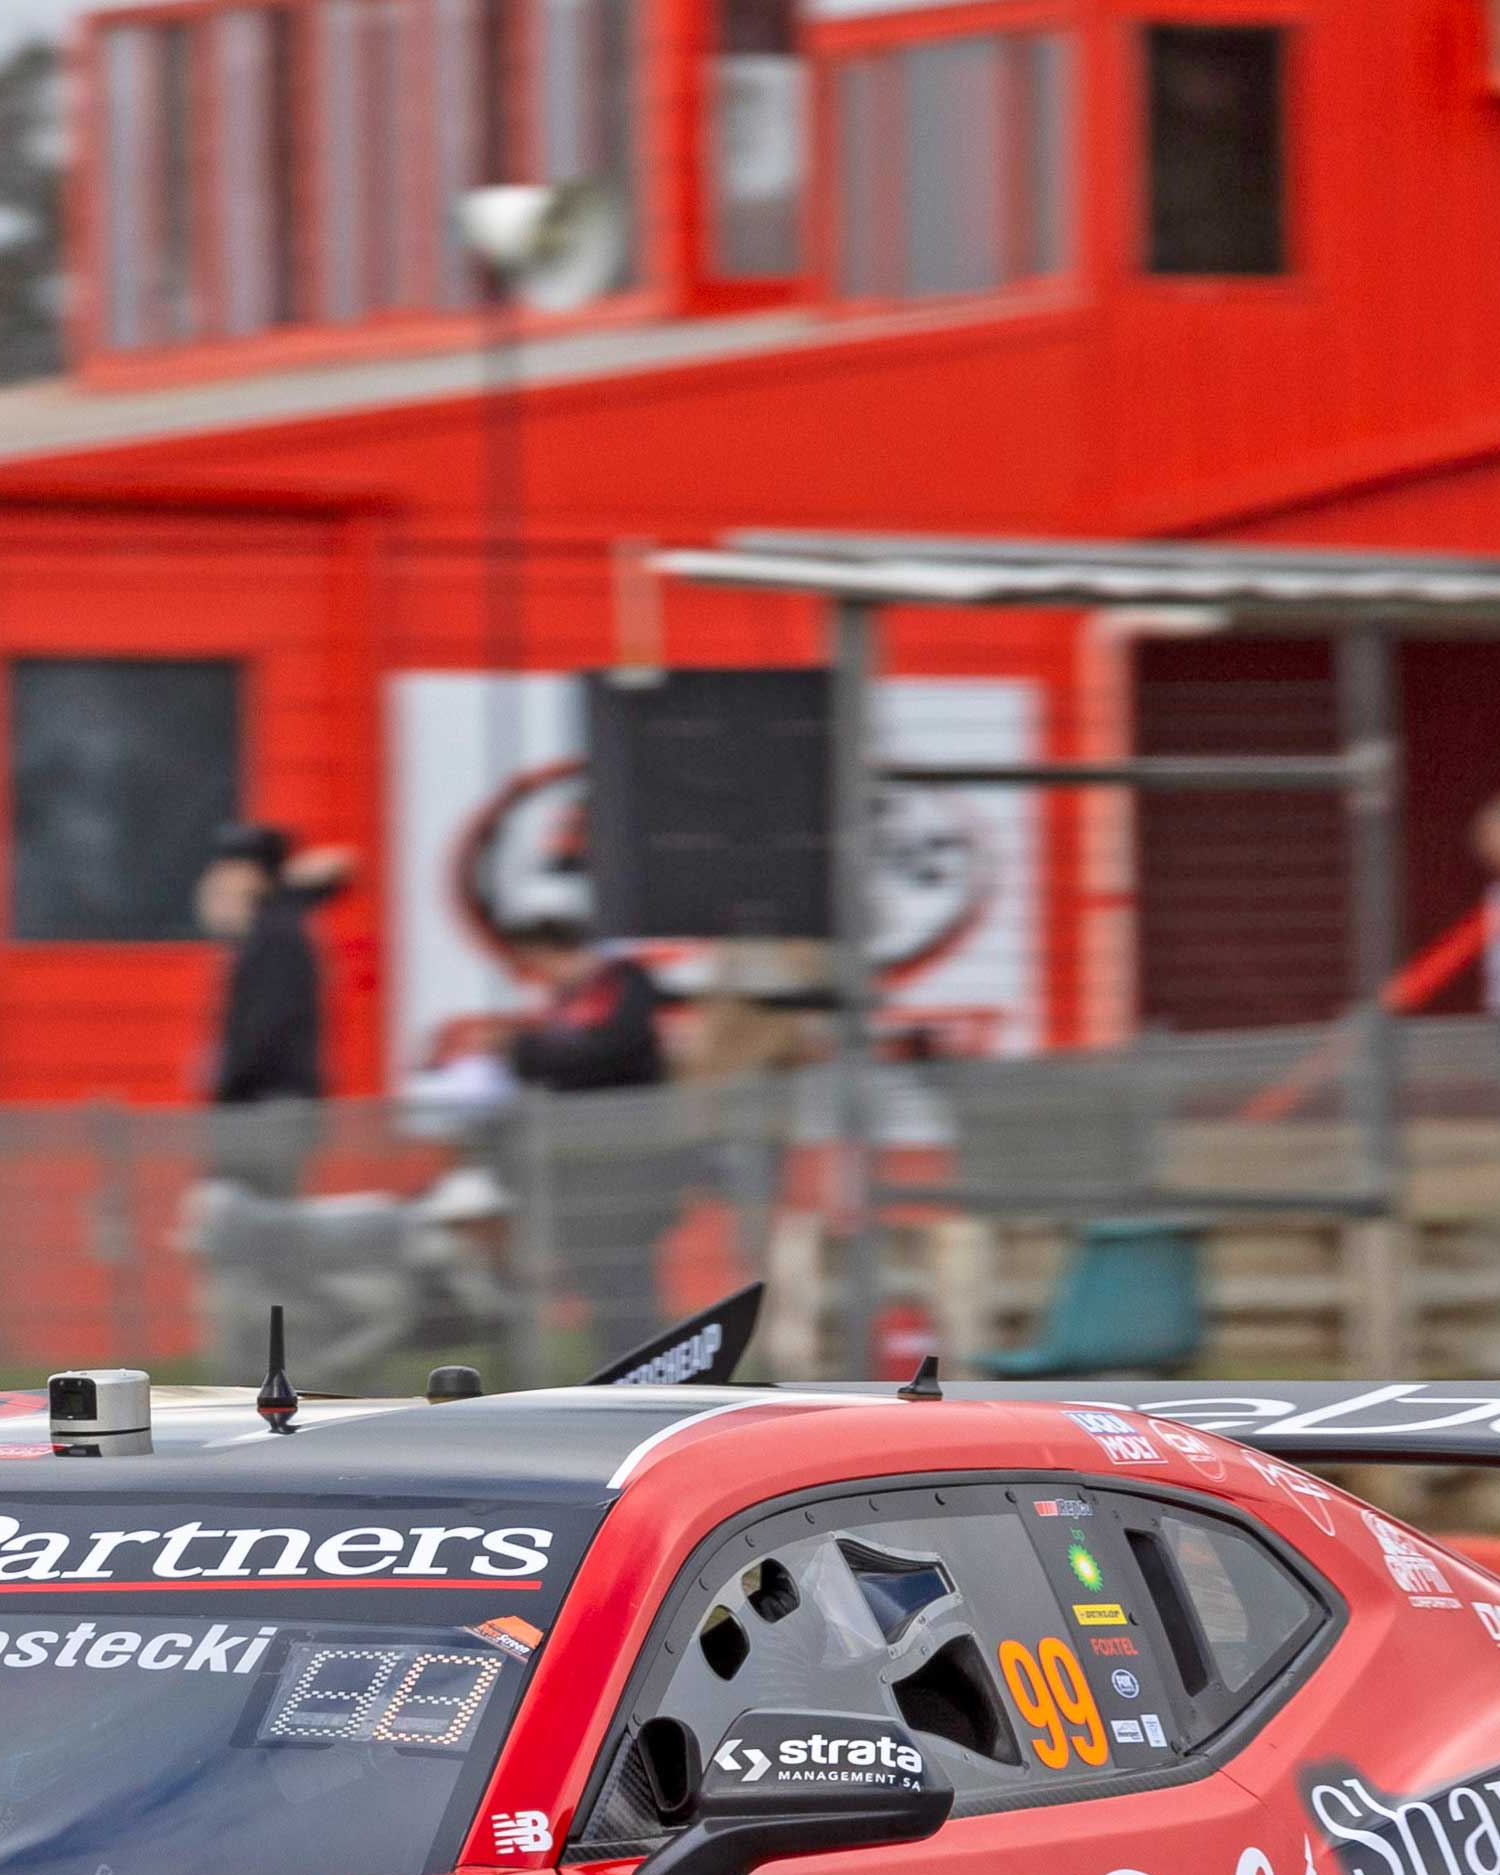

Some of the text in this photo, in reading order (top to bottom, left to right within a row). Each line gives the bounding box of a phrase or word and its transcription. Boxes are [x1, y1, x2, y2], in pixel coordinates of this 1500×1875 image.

[1098, 1435, 1160, 1461] MOLY
[1090, 1637, 1140, 1656] FOXTEL
[1000, 1637, 1109, 1769] 99
[778, 1734, 923, 1773] strata
[778, 1770, 921, 1792] MANAGEMENT SA
